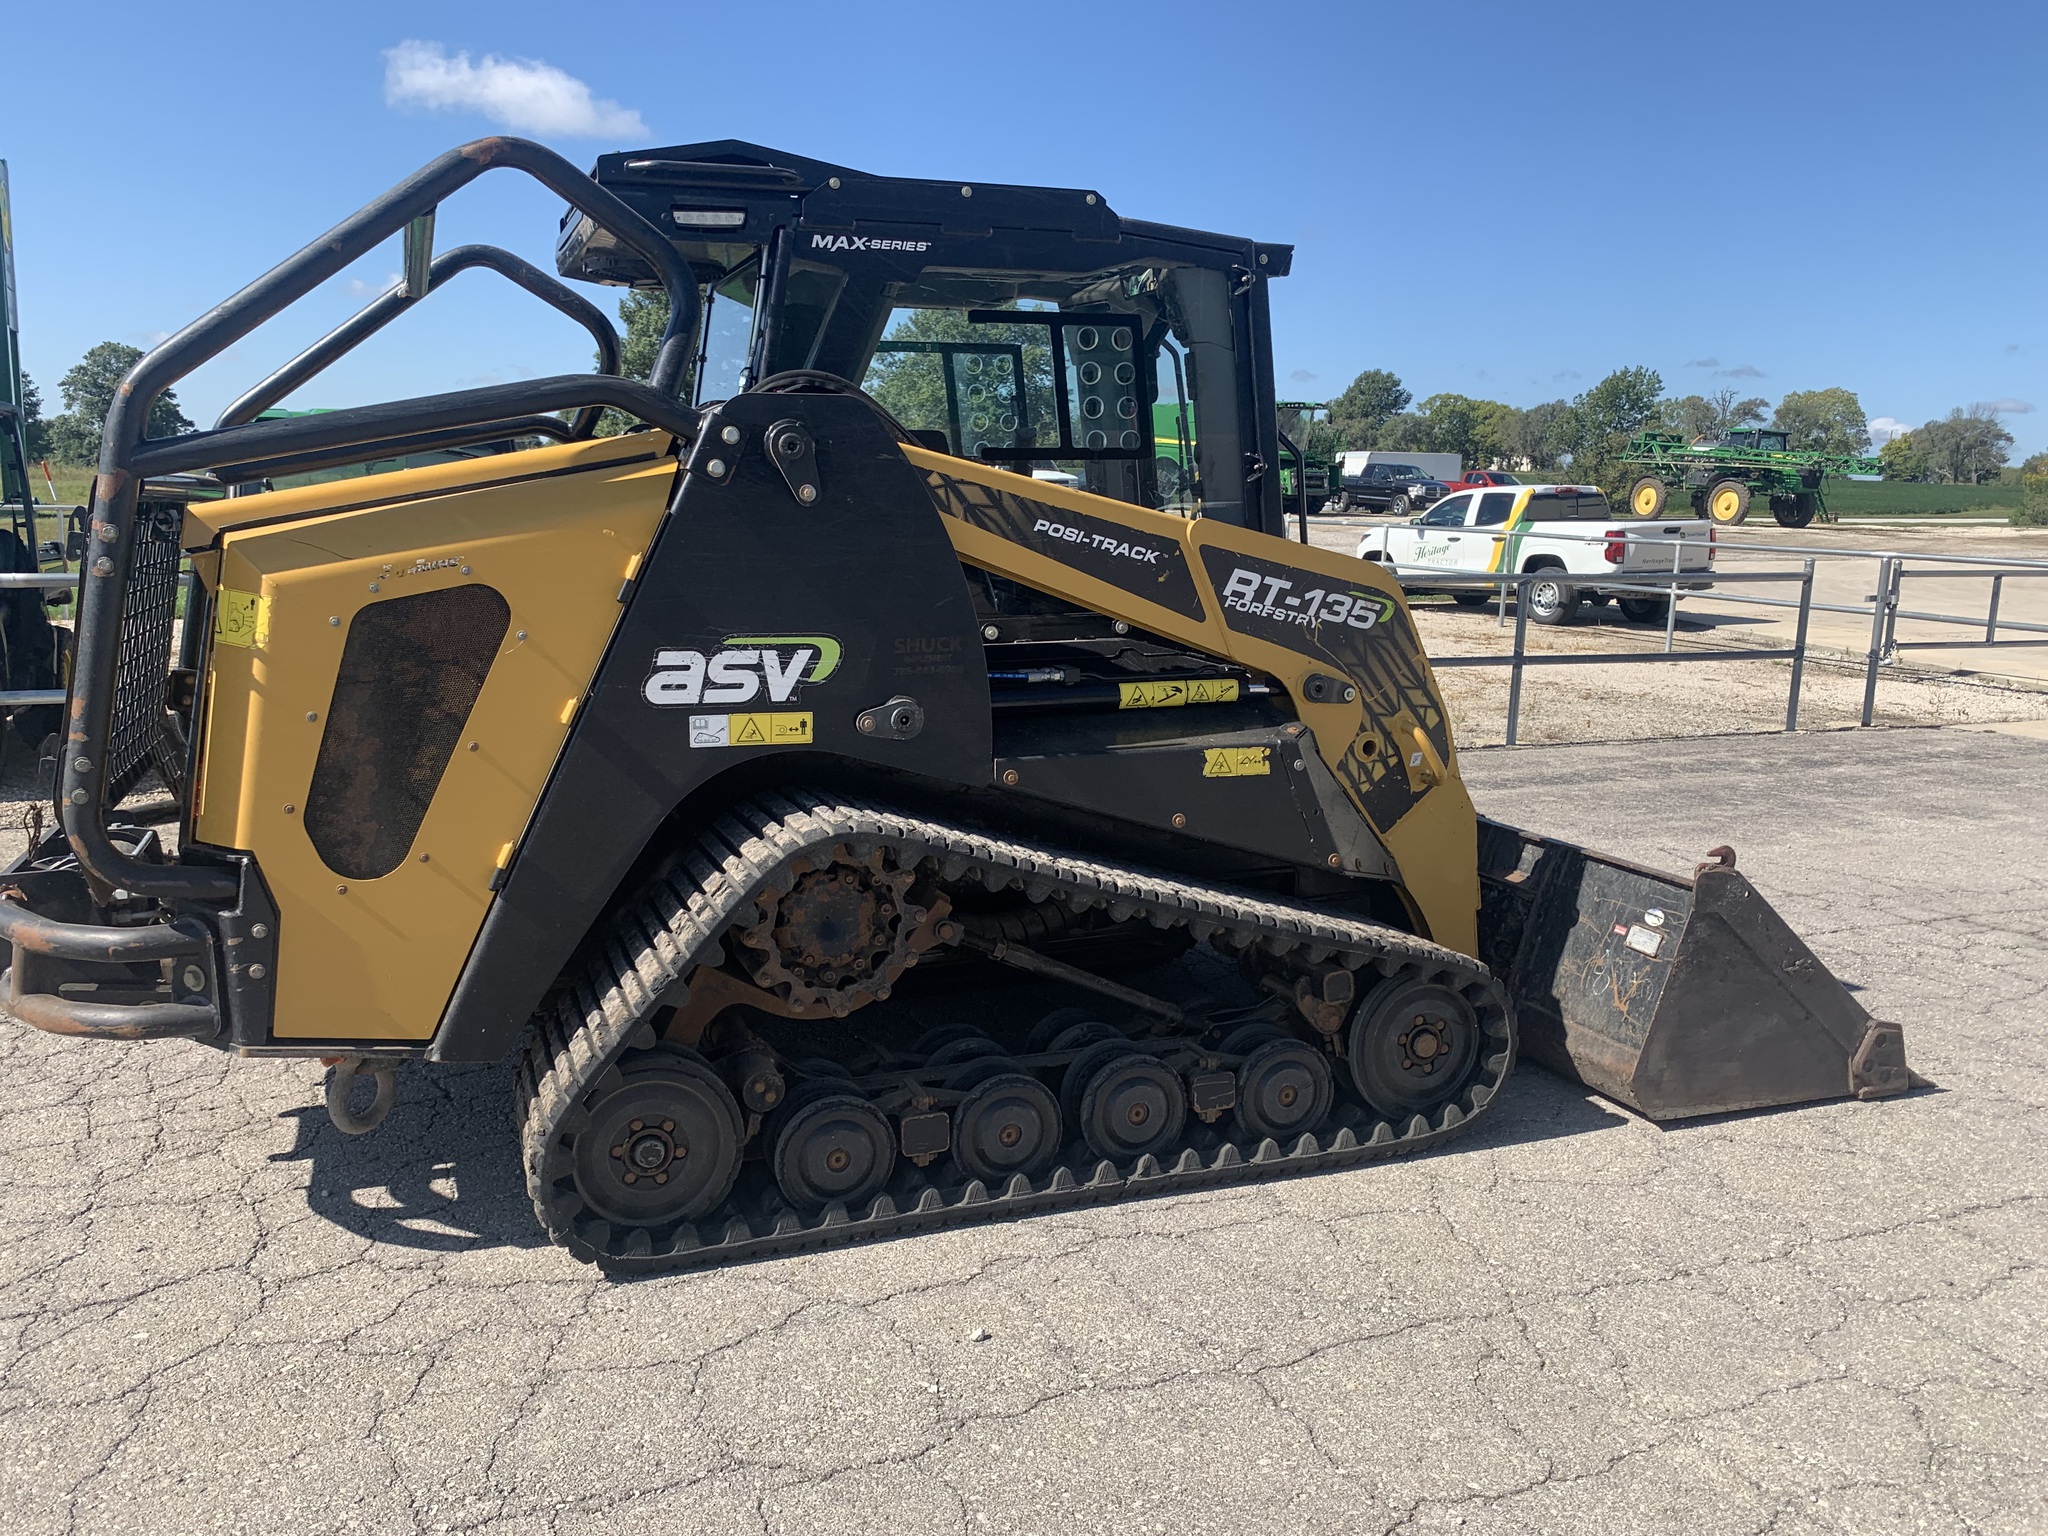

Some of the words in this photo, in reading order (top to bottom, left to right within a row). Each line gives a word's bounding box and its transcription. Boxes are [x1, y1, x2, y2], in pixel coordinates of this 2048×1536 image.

[811, 234, 929, 252] MAX-SERIES
[1033, 519, 1160, 565] POSI-TRACK
[1413, 544, 1451, 562] Heritage
[1641, 557, 1694, 565] HeritageTrac.com
[1222, 568, 1382, 630] RT-135
[1224, 596, 1322, 629] FORESTRY
